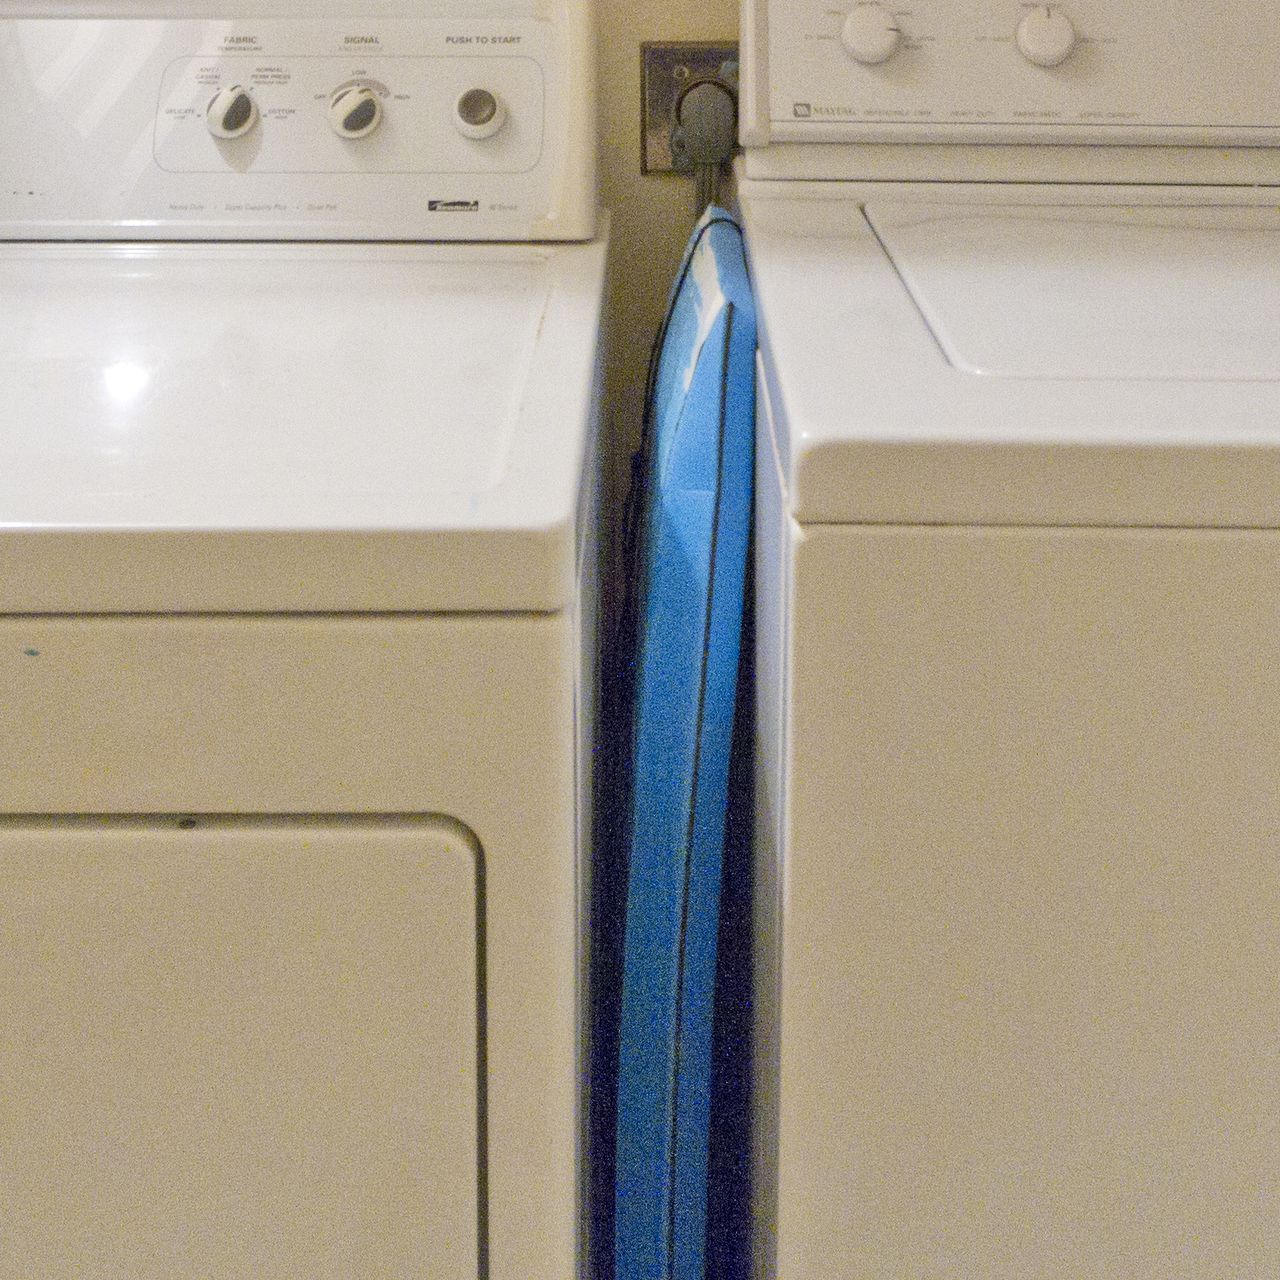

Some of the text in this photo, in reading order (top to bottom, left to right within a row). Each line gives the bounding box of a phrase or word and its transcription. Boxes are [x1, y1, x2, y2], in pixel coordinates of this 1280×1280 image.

[224, 36, 257, 44] FABRIC
[344, 36, 379, 44] SIGNAL
[445, 36, 522, 44] PUSH TO START
